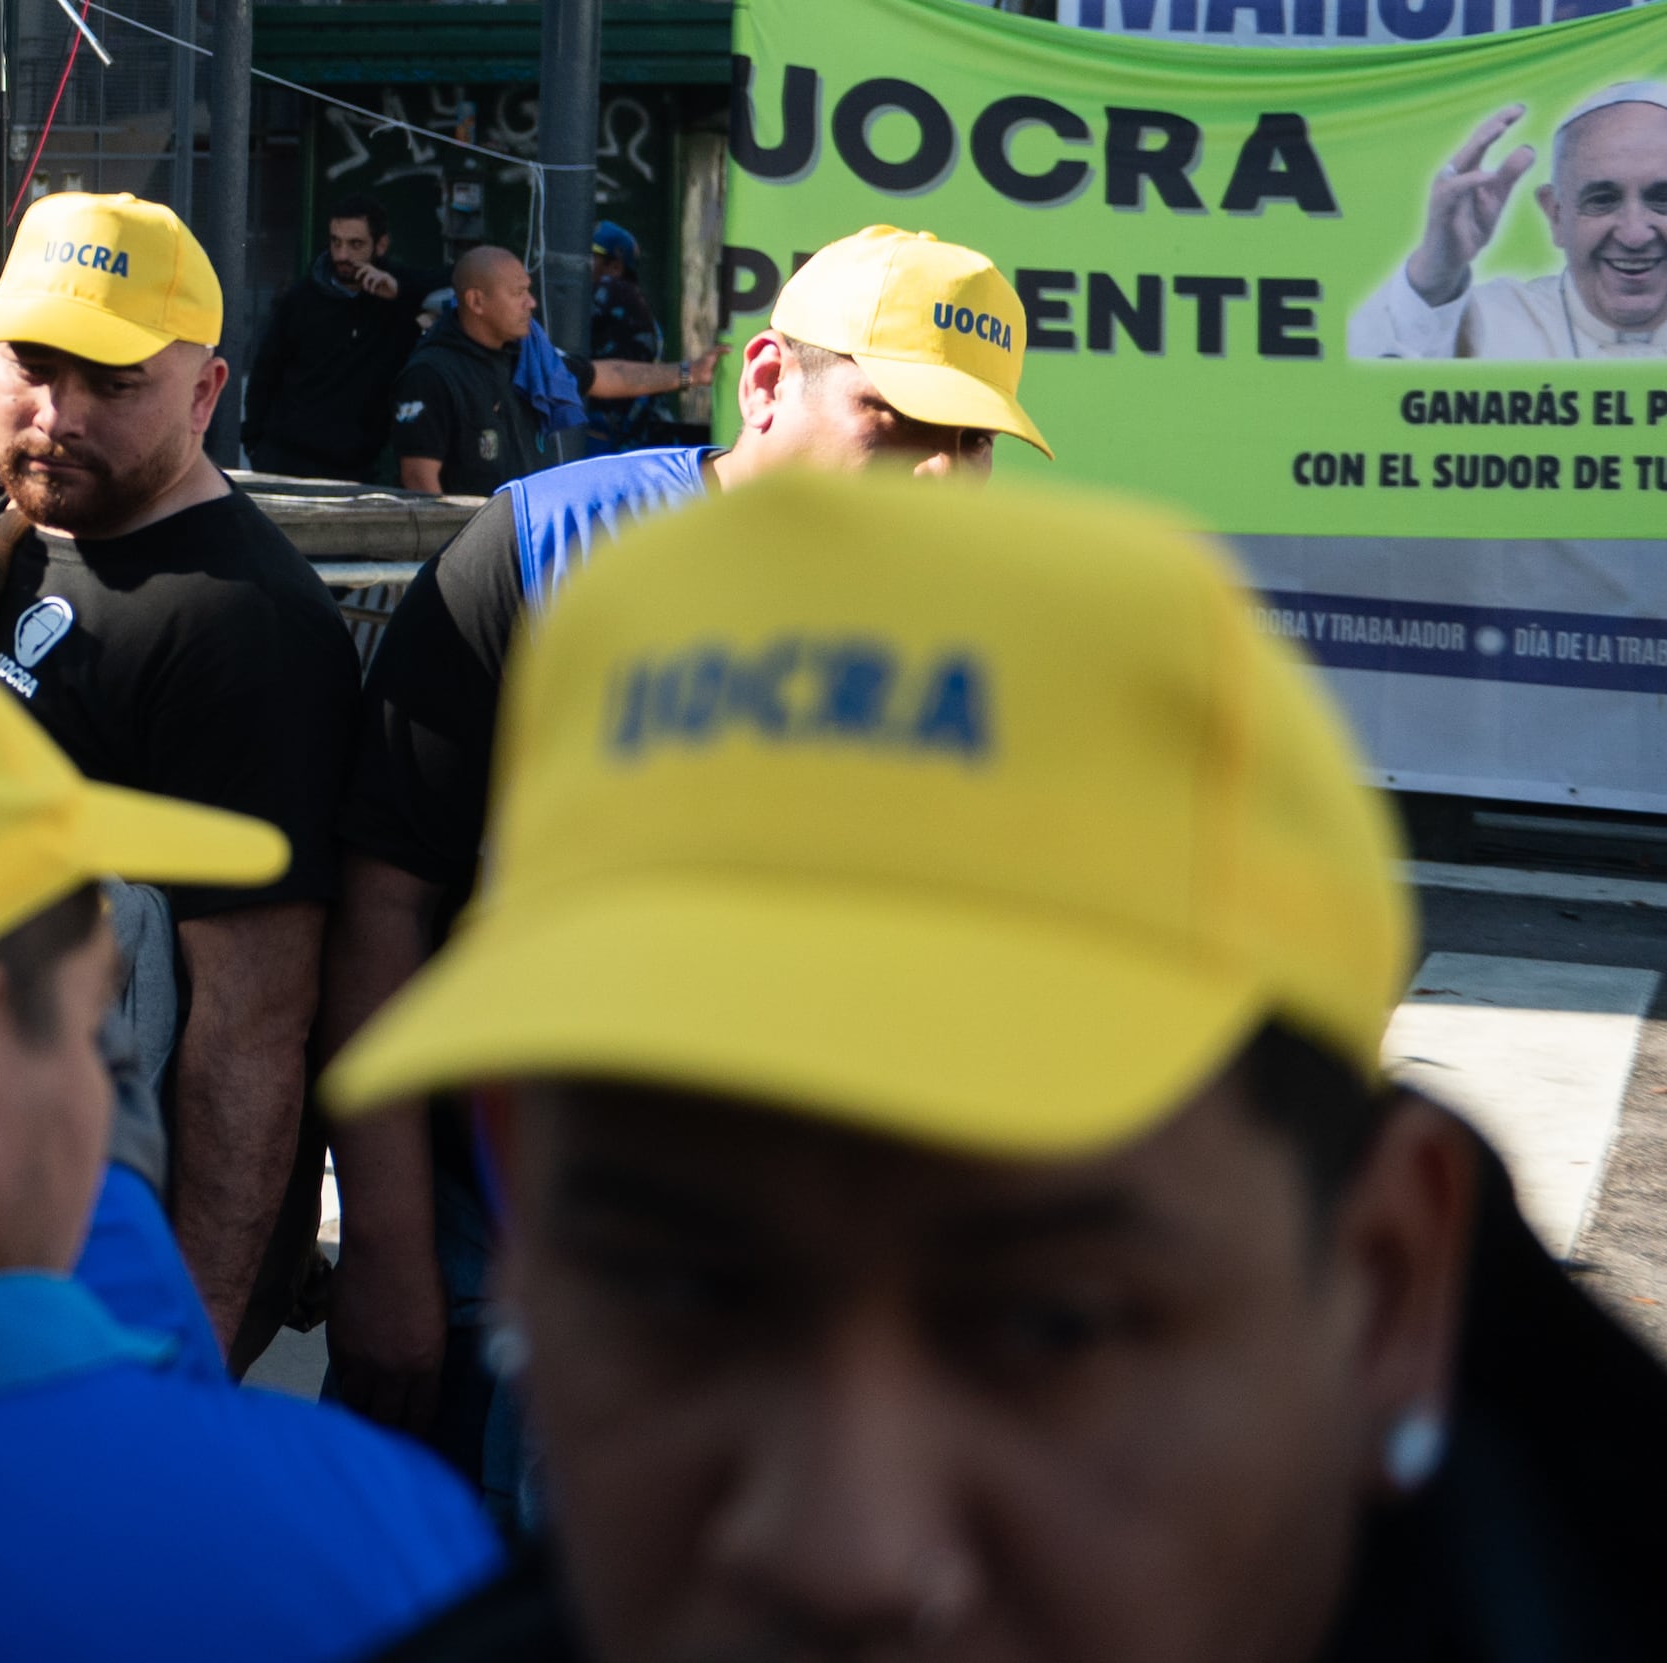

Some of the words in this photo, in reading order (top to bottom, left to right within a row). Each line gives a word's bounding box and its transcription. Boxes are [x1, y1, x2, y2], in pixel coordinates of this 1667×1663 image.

[730, 53, 1341, 218] UOCRA
[44, 240, 129, 279] UOCRA
[932, 301, 1012, 353] UOCRA
[1400, 383, 1580, 426] GANARÁS
[1591, 390, 1634, 426] EL
[1291, 452, 1365, 488] CON
[1378, 453, 1420, 488] EL
[1432, 454, 1561, 490] SUDOR
[1573, 456, 1622, 490] DE
[1311, 612, 1328, 640] Y
[1329, 614, 1466, 652] TRABAJADOR
[1514, 622, 1550, 658] DÍA
[1556, 631, 1581, 660] DE
[1586, 634, 1611, 664] LA
[608, 626, 995, 766] UOCRA
